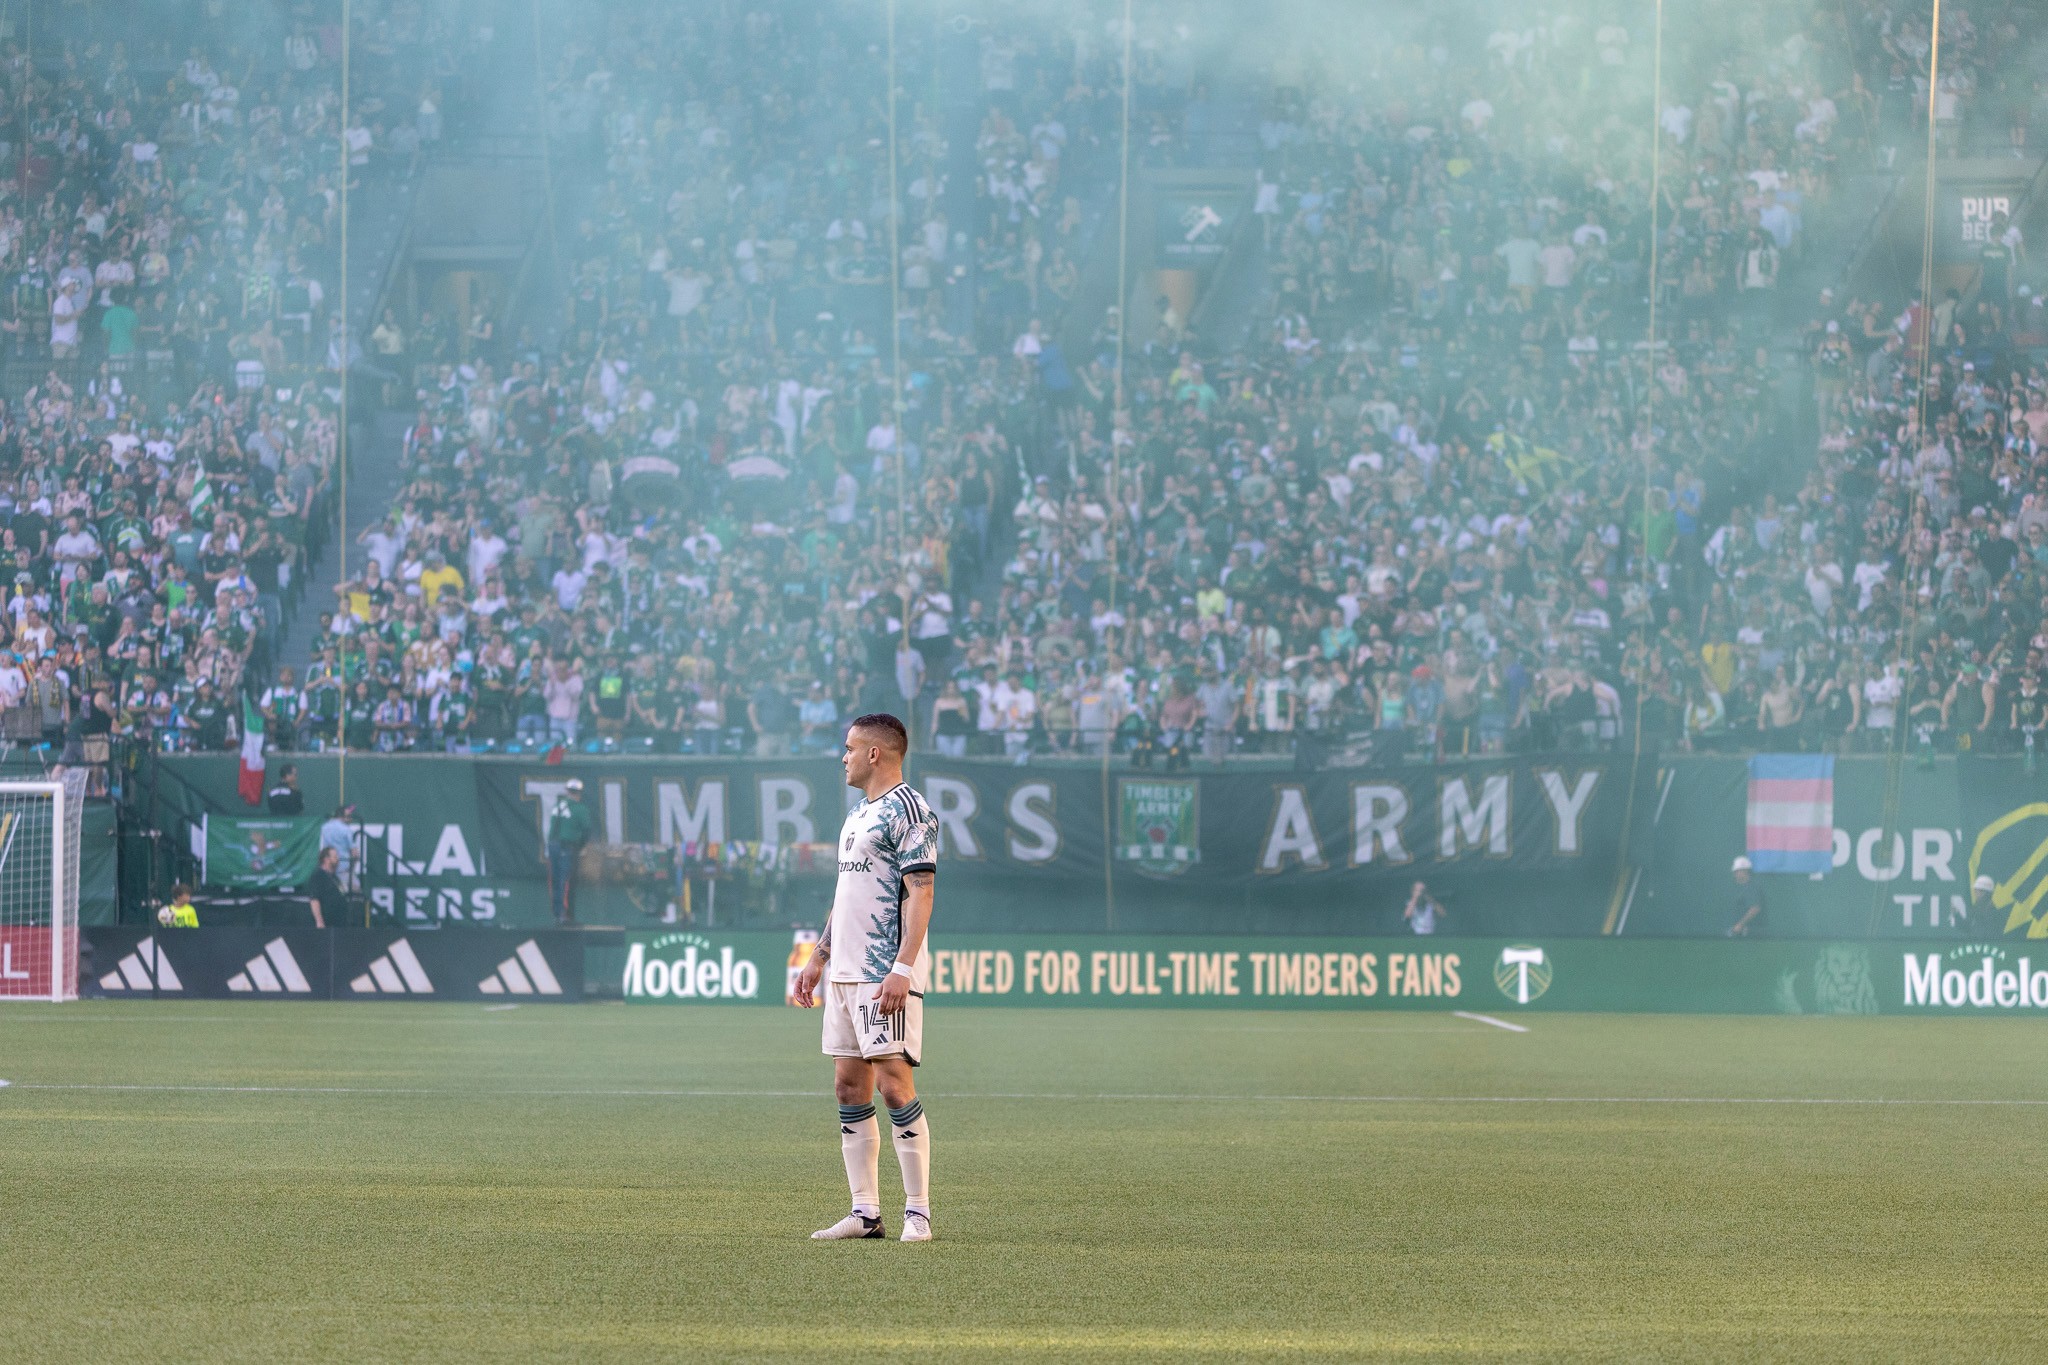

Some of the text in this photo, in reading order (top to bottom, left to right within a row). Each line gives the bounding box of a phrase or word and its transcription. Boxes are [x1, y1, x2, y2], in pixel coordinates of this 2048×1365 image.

[521, 768, 1602, 871] TIMBRS ARMY
[349, 824, 486, 876] TLA
[1810, 828, 1963, 881] OR
[0, 943, 29, 979] L
[1024, 951, 1081, 995] FOR
[1091, 952, 1240, 995] FULL-TIME
[1249, 953, 1378, 997] TIMBERS
[1388, 953, 1462, 997] FANS
[1903, 953, 2048, 1008] Modelo
[859, 1003, 889, 1034] 14
